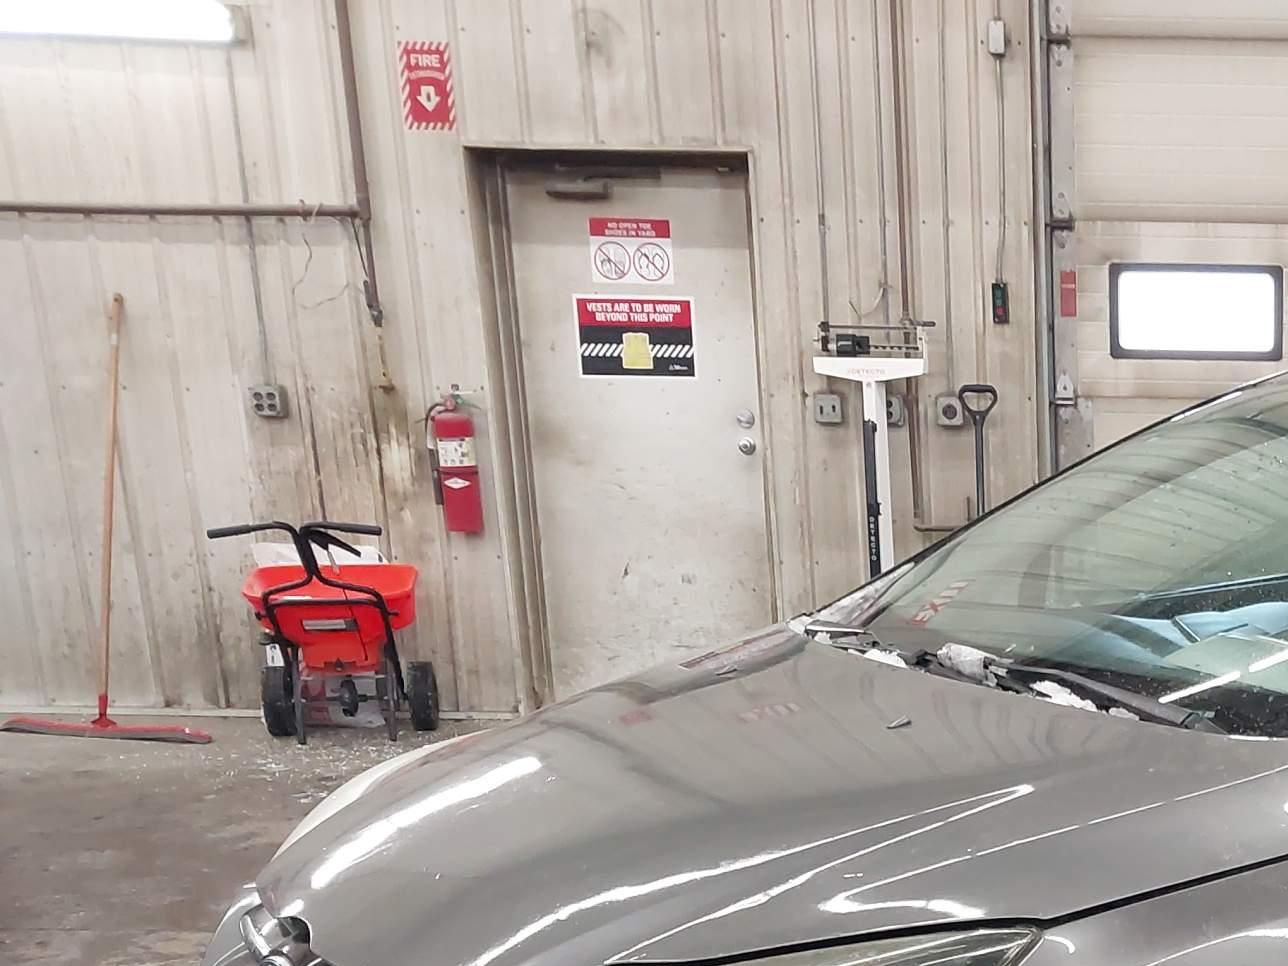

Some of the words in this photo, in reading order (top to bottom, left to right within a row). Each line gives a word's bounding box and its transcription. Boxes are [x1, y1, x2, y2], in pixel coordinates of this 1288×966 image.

[409, 53, 441, 67] FIRE
[586, 302, 613, 312] VESTS
[613, 302, 630, 312] ARE
[631, 303, 642, 313] TO
[643, 303, 655, 313] BE
[655, 303, 681, 313] WORN
[595, 312, 628, 322] BEYOND
[629, 313, 648, 322] THIS
[649, 313, 674, 323] POINT
